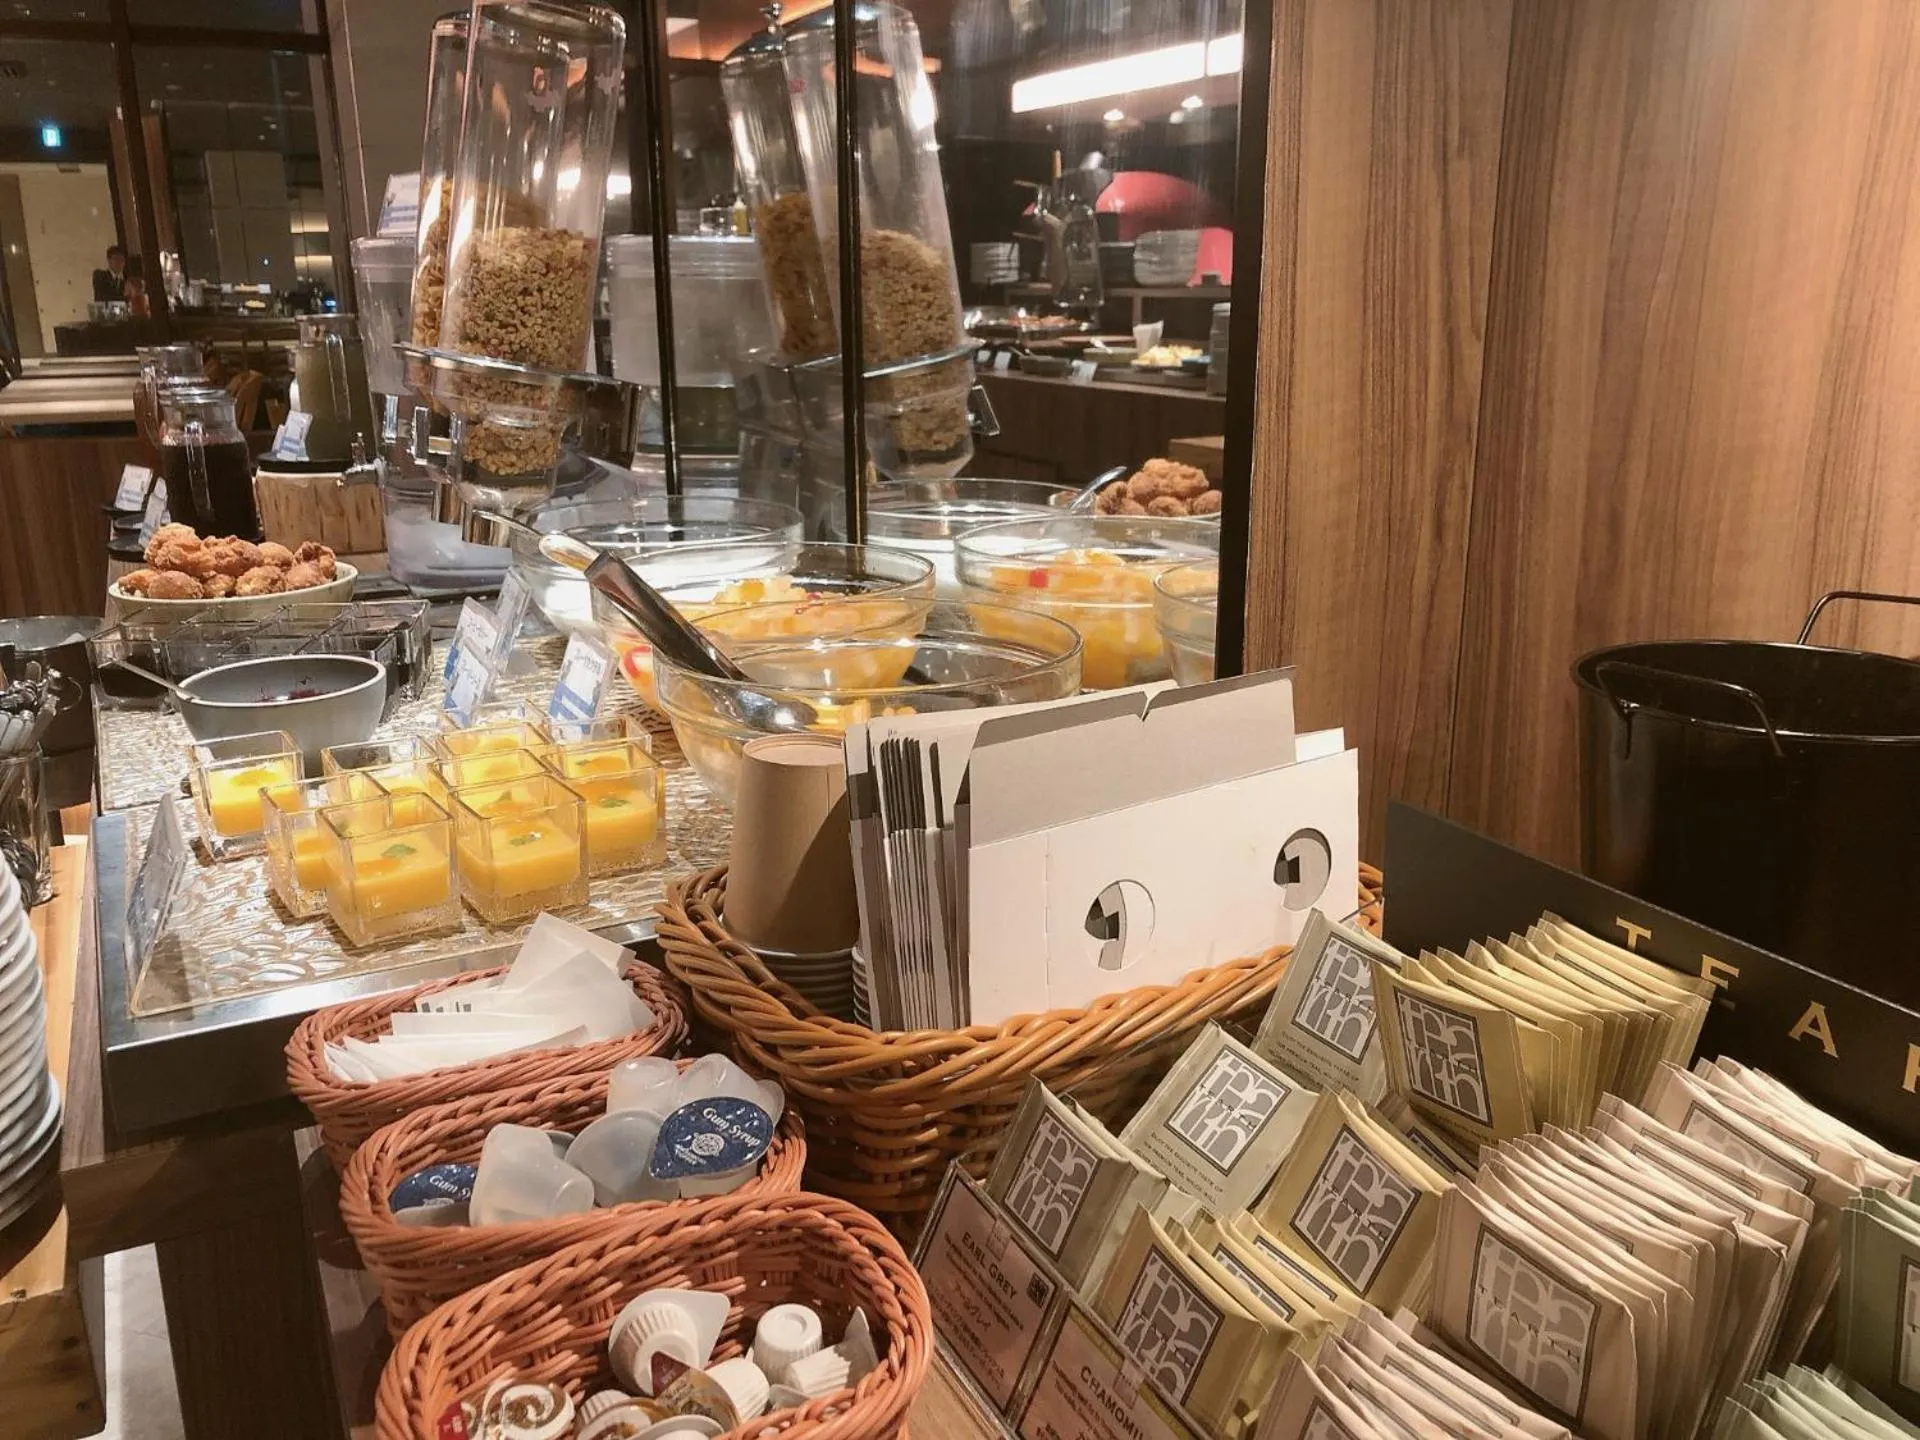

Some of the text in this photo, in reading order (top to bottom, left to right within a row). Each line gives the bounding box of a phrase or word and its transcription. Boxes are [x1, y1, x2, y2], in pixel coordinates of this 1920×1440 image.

[703, 1107, 761, 1148] Gum Syrup
[429, 1174, 458, 1194] Gum
[962, 1231, 987, 1269] EARL
[987, 1263, 1017, 1300] GREY
